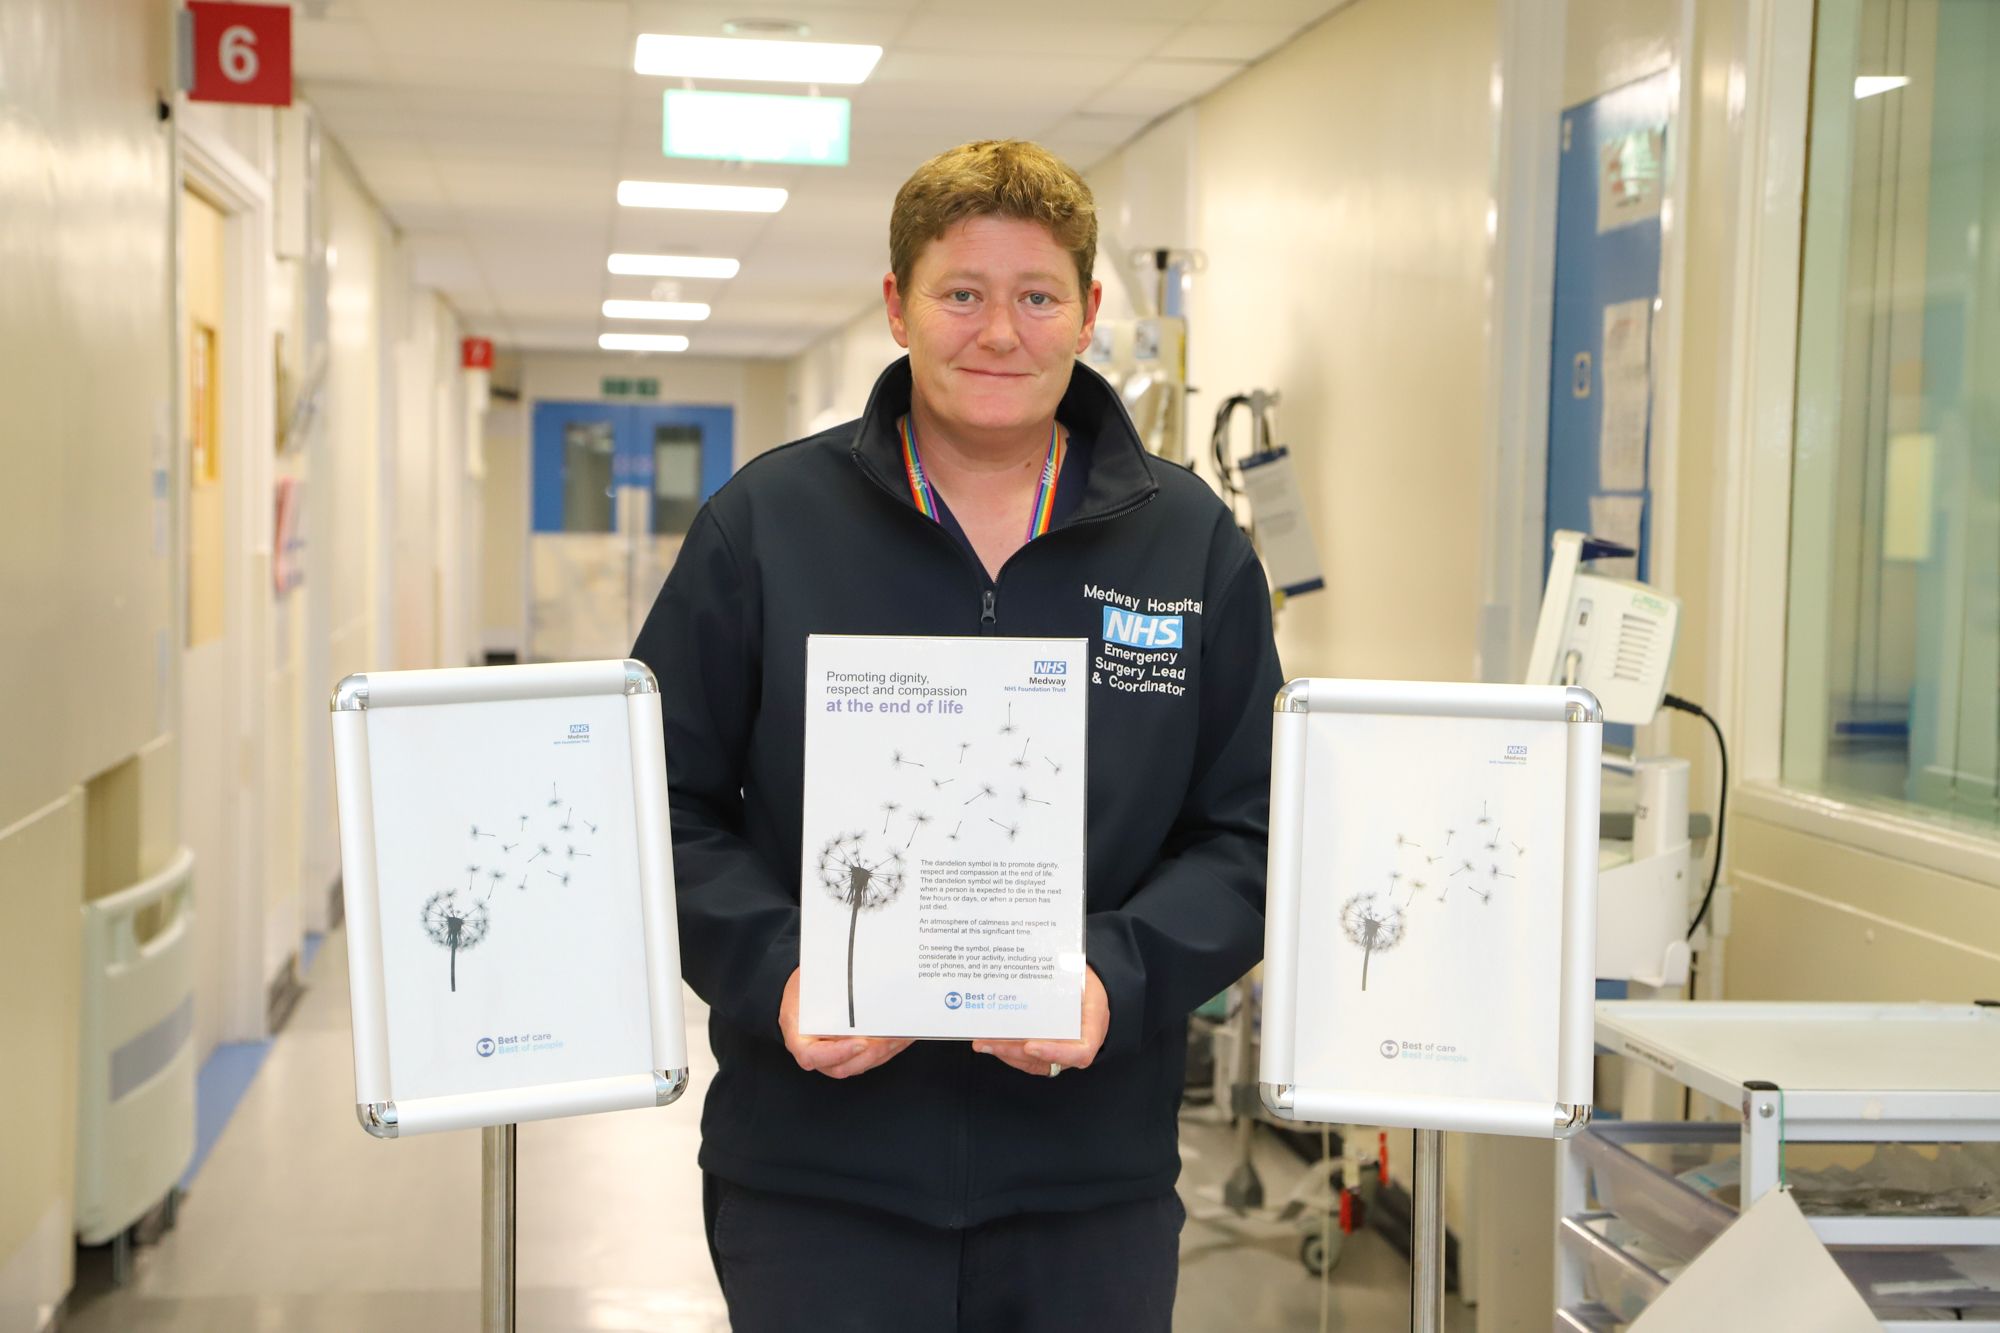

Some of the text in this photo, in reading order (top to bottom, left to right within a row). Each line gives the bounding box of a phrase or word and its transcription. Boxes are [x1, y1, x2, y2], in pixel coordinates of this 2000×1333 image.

[219, 26, 258, 83] 6
[1042, 459, 1058, 489] NHS
[1084, 584, 1202, 615] Medway Hospital
[1106, 609, 1180, 646] NHS
[1105, 643, 1178, 665] Emergency
[1035, 661, 1066, 674] NHS
[1096, 657, 1186, 680] Surgery Lead
[827, 671, 929, 685] Promoting dignity,
[1029, 677, 1066, 686] Medway
[1092, 672, 1185, 696] & Coordinator
[826, 685, 966, 698] respect and compassion
[826, 699, 963, 714] at the end of life
[570, 724, 589, 733] NHS
[935, 859, 966, 867] dandelion
[968, 860, 991, 869] symbol
[1008, 861, 1035, 869] promote
[920, 868, 944, 876] respect
[960, 869, 998, 878] compassion
[968, 878, 991, 886] symbol
[1015, 879, 1045, 887] displayed
[977, 887, 1006, 895] expected
[919, 903, 931, 911] just
[930, 918, 968, 927] atmosphere
[1025, 920, 1049, 928] respect
[919, 926, 959, 934] fundamental
[983, 928, 1015, 936] significant
[931, 944, 952, 953] seeing
[993, 945, 1014, 954] please
[1008, 954, 1036, 963] including
[919, 970, 940, 979] people
[983, 972, 1009, 980] grieving
[498, 1036, 518, 1044] Best
[521, 1034, 529, 1042] of
[1402, 1042, 1422, 1050] Best
[1425, 1043, 1434, 1051] of
